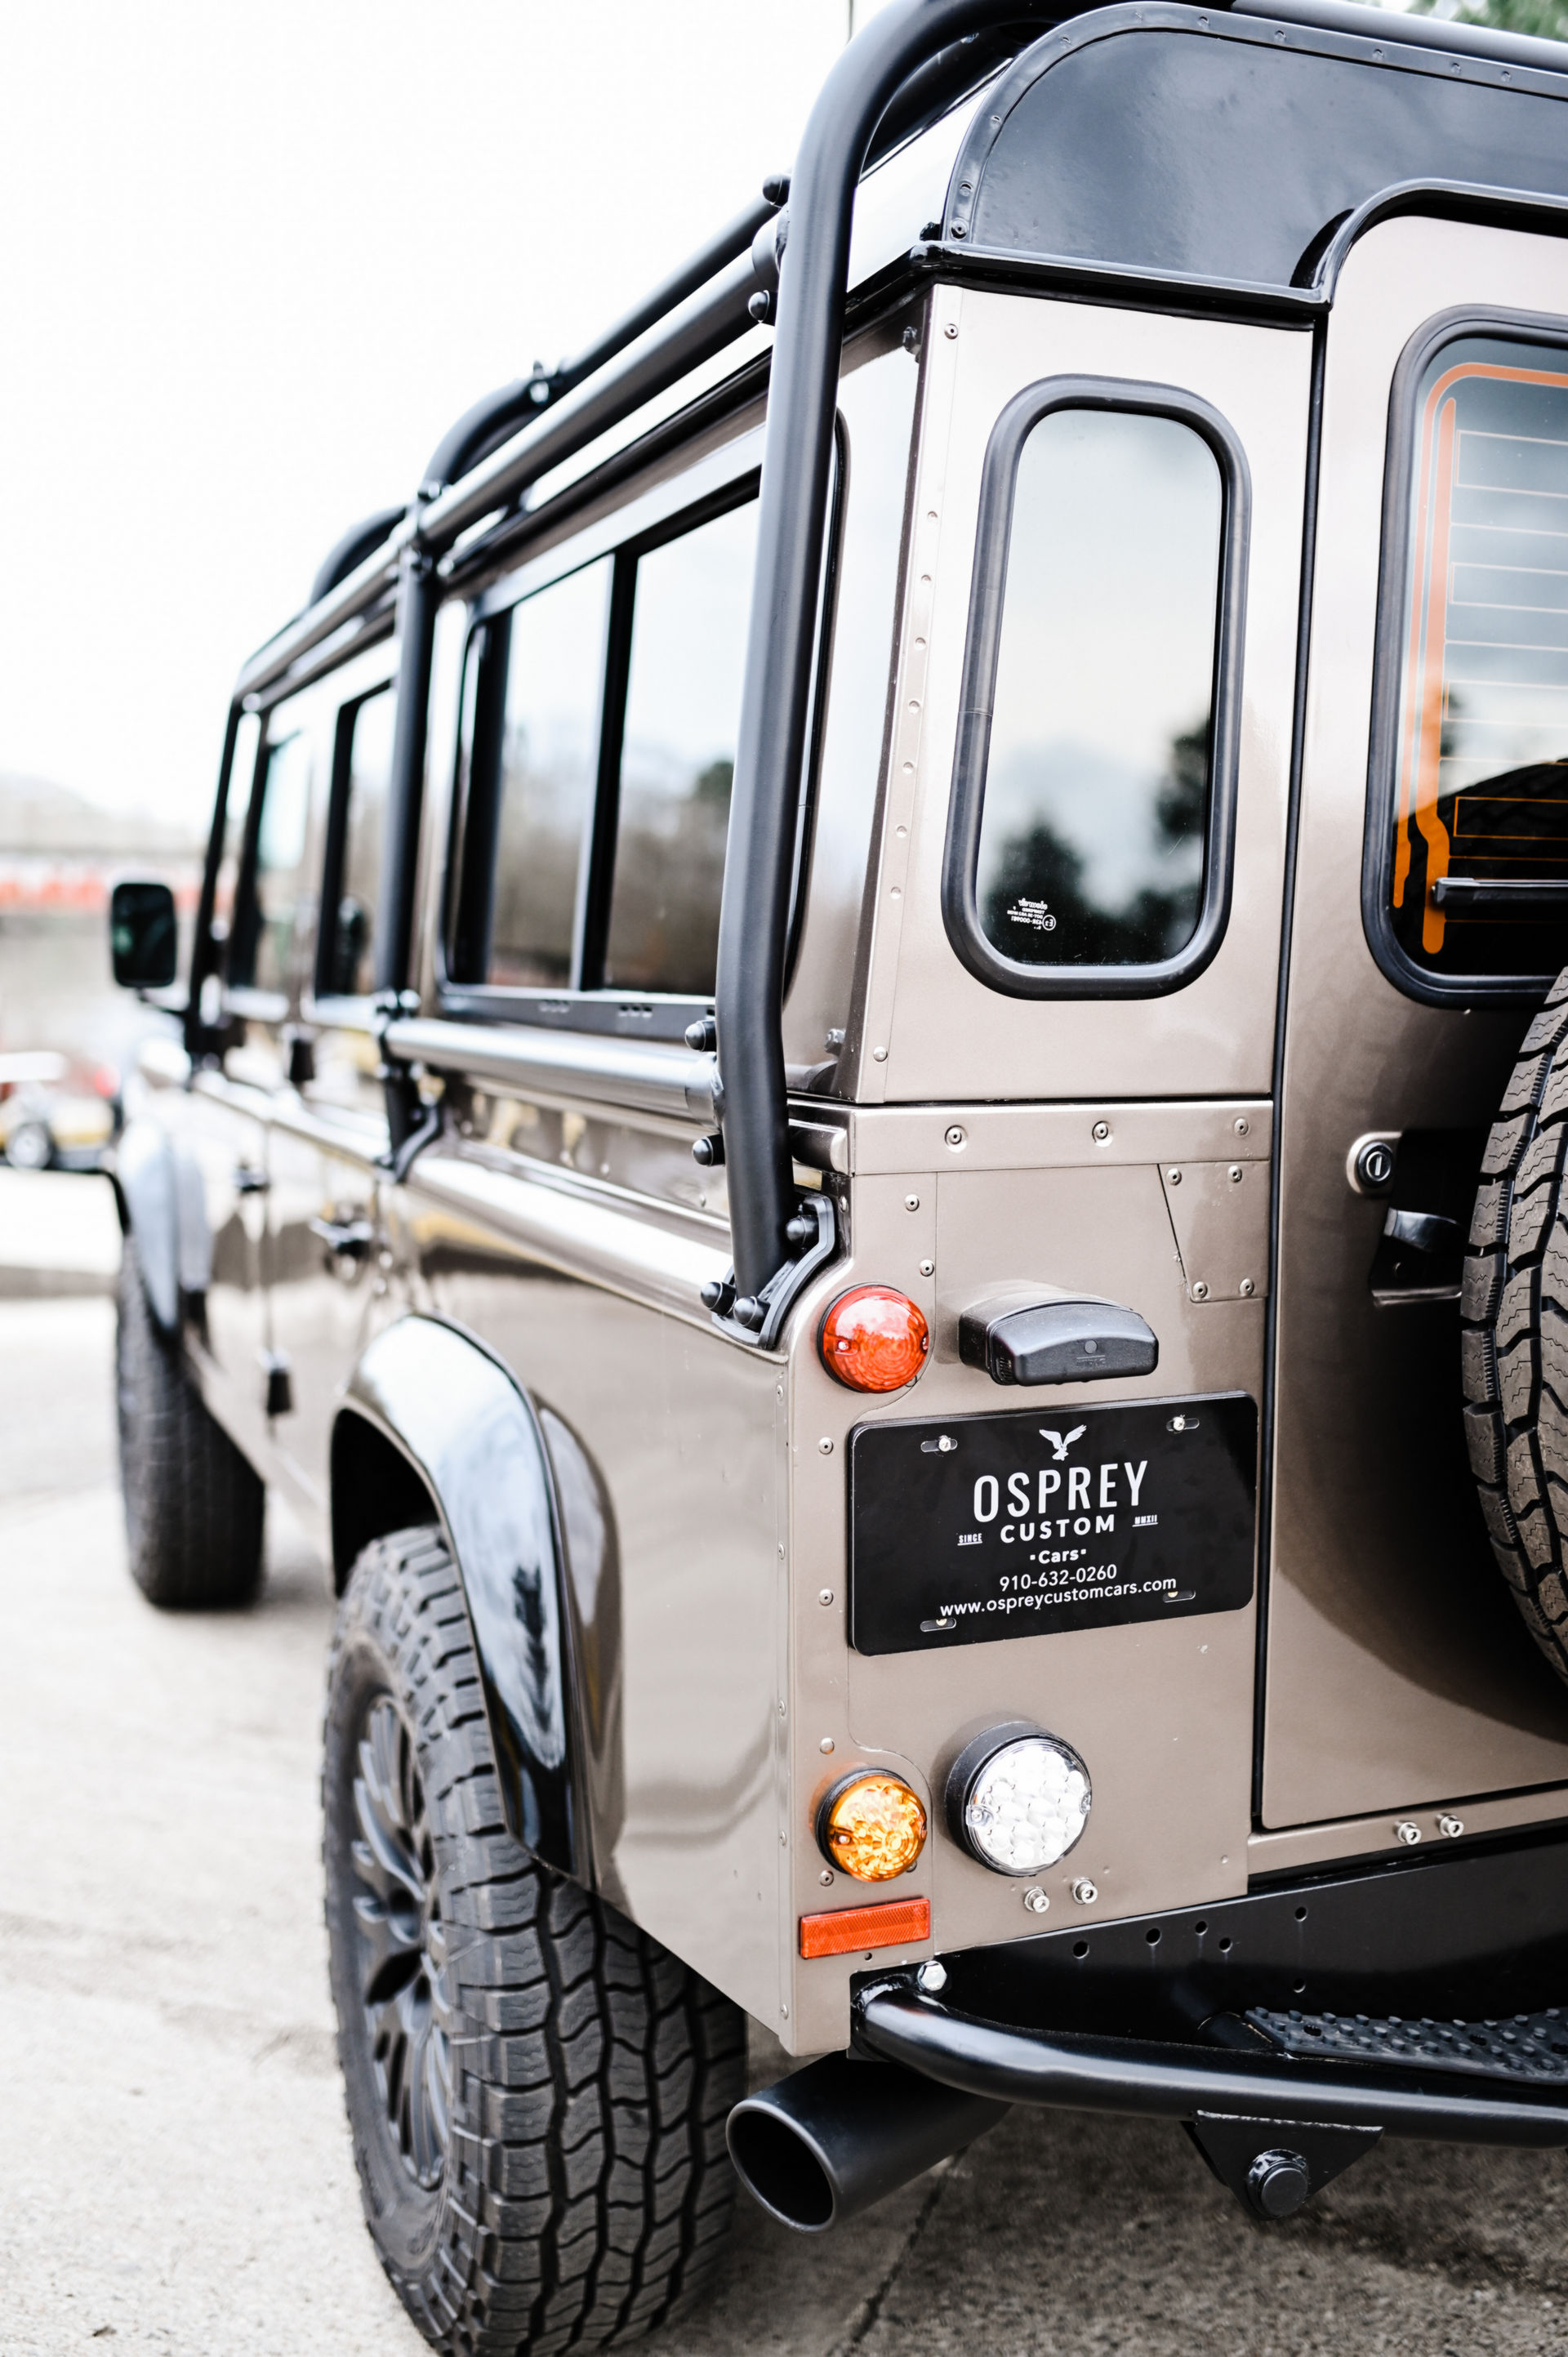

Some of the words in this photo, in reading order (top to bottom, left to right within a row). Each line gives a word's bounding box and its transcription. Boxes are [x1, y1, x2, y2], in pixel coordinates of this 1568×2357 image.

[973, 1460, 1148, 1523] OSPREY
[958, 1533, 983, 1544] SINCE
[1000, 1513, 1115, 1544] CUSTOM
[1000, 1563, 1117, 1592] 910-632-0260
[940, 1578, 1177, 1617] www.ospreycustomcars.com
